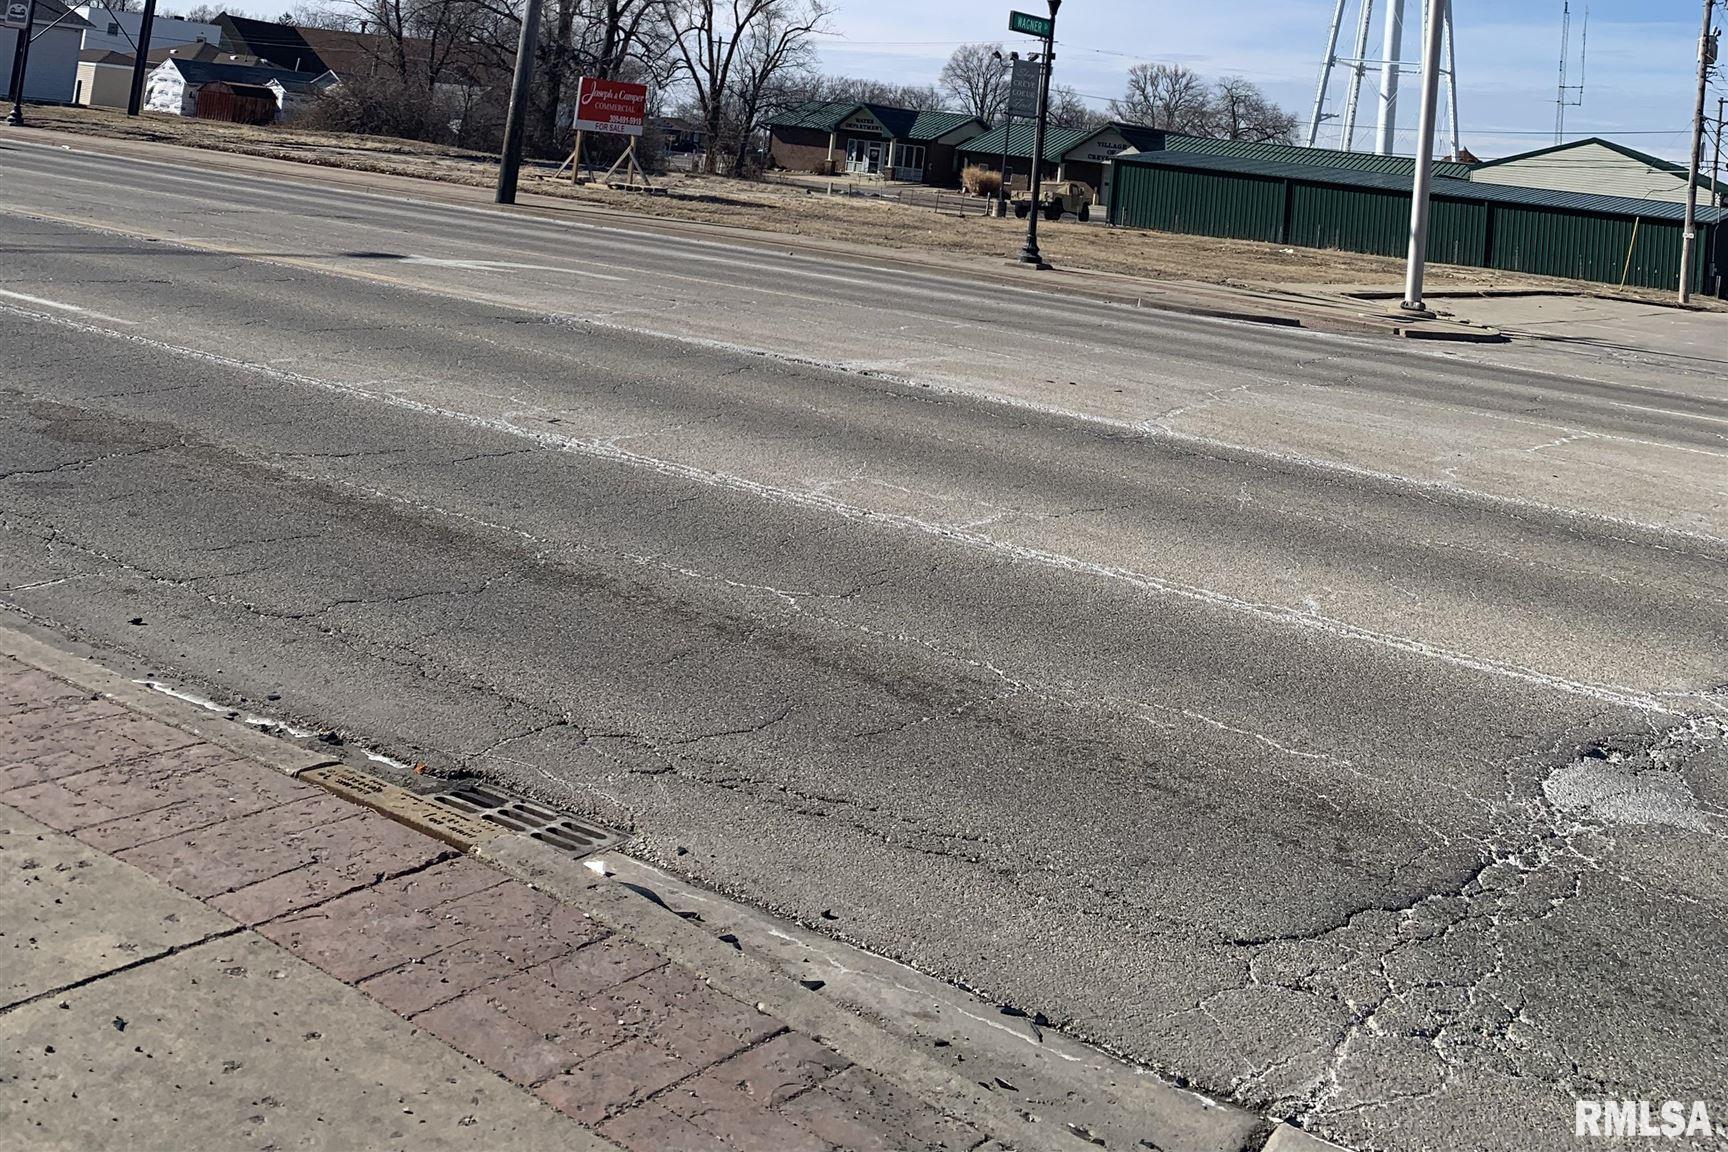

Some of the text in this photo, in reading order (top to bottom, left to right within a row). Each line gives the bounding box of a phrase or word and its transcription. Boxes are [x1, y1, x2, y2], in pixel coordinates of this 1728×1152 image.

[1017, 16, 1043, 33] WAGNER
[581, 80, 613, 105] Joseph
[594, 102, 635, 113] COMMERCIAL
[595, 122, 625, 133] FOR SALE
[1097, 141, 1127, 149] VILLAGE
